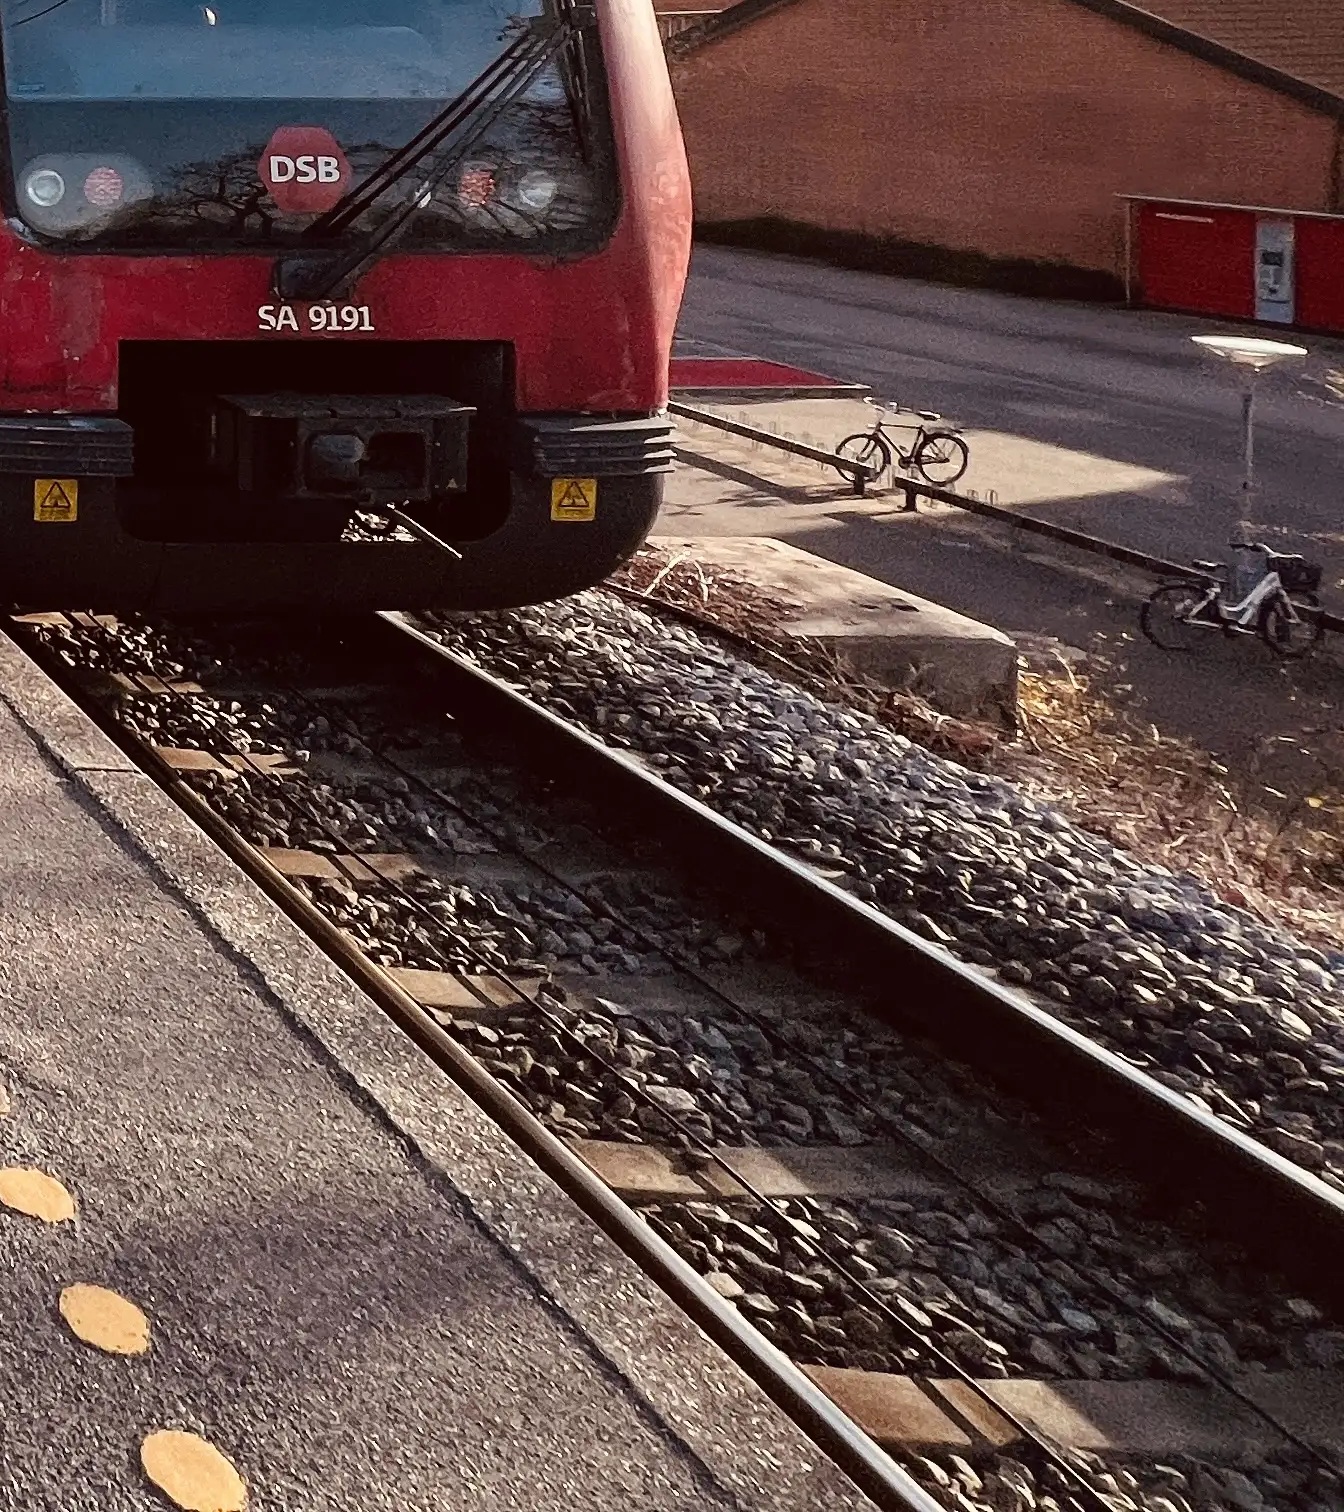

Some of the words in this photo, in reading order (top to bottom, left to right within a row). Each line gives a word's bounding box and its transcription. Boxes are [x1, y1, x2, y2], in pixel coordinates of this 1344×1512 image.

[269, 155, 341, 183] DSB
[258, 305, 299, 332] SA
[308, 305, 375, 332] 9191
